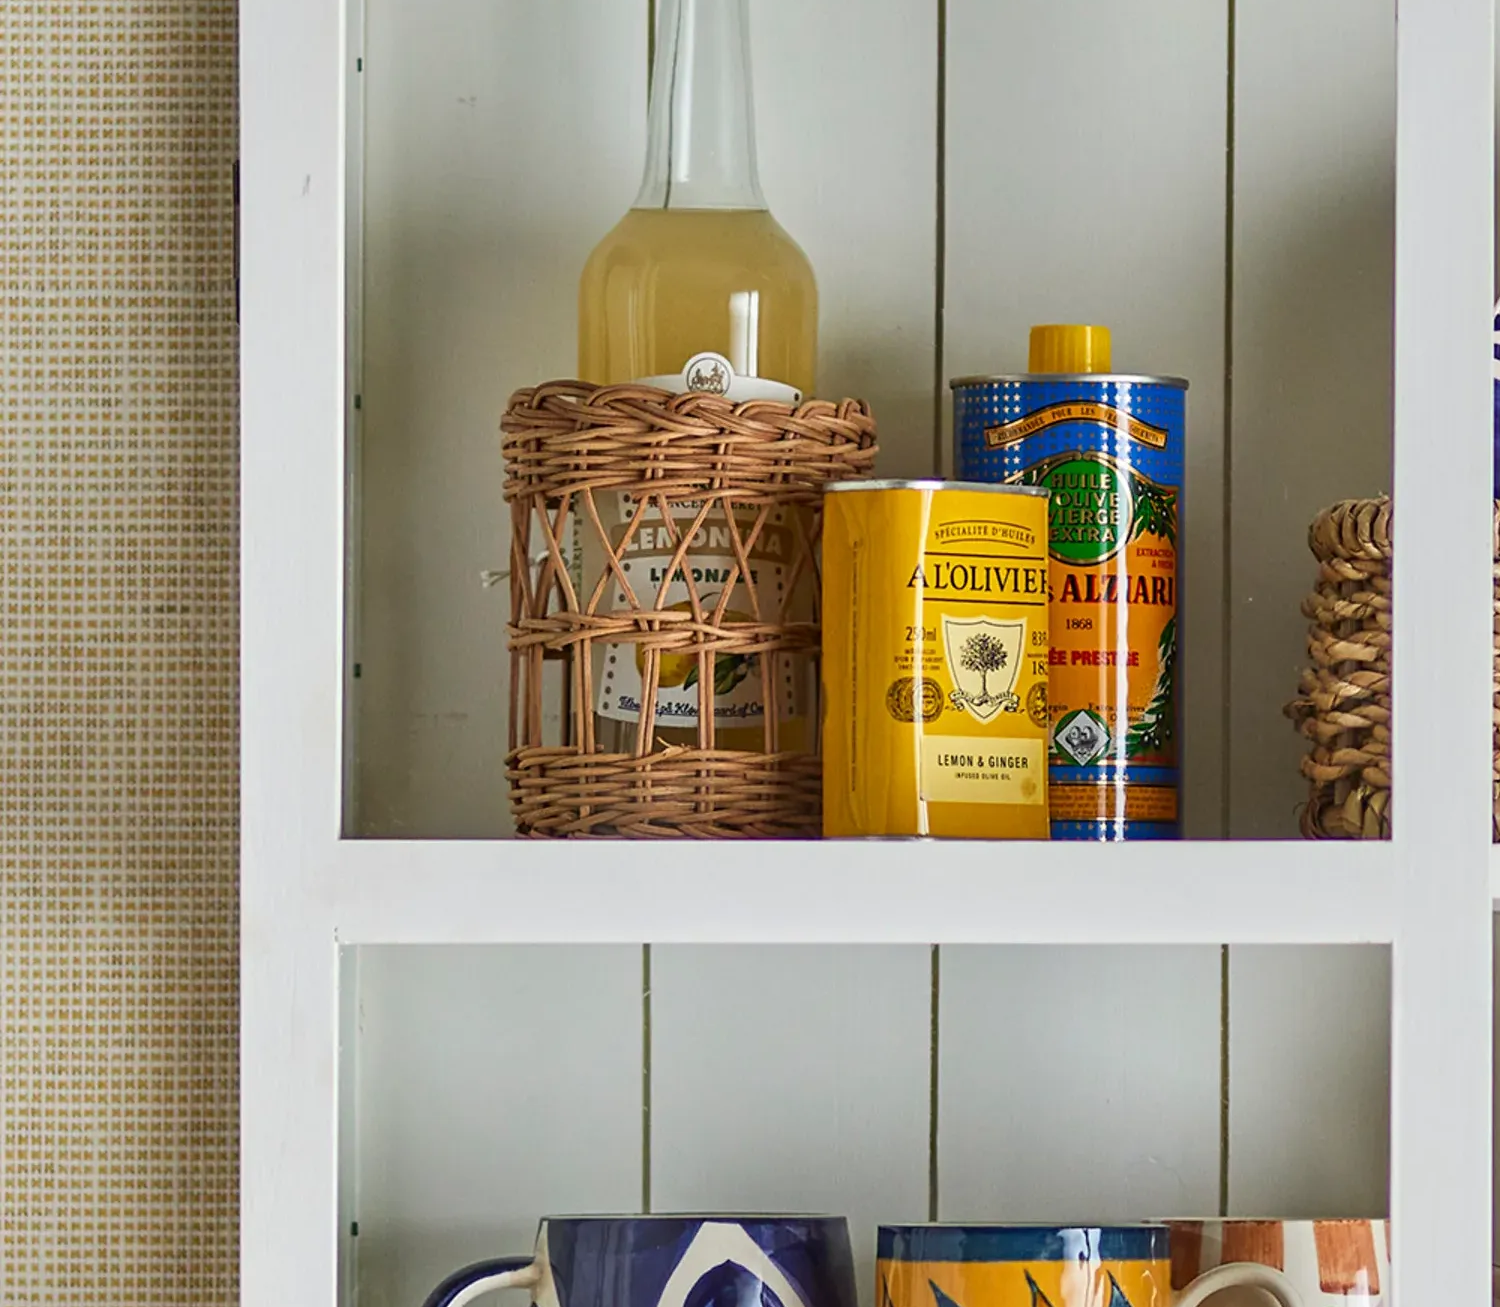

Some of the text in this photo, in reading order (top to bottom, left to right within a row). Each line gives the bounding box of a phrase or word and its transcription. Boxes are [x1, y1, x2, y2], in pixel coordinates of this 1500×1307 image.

[1051, 474, 1112, 489] HUILE
[1048, 527, 1115, 543] EXTRA
[907, 564, 930, 588] A
[1066, 618, 1093, 630] 1868
[937, 754, 1029, 769] LEMON & GINGER
